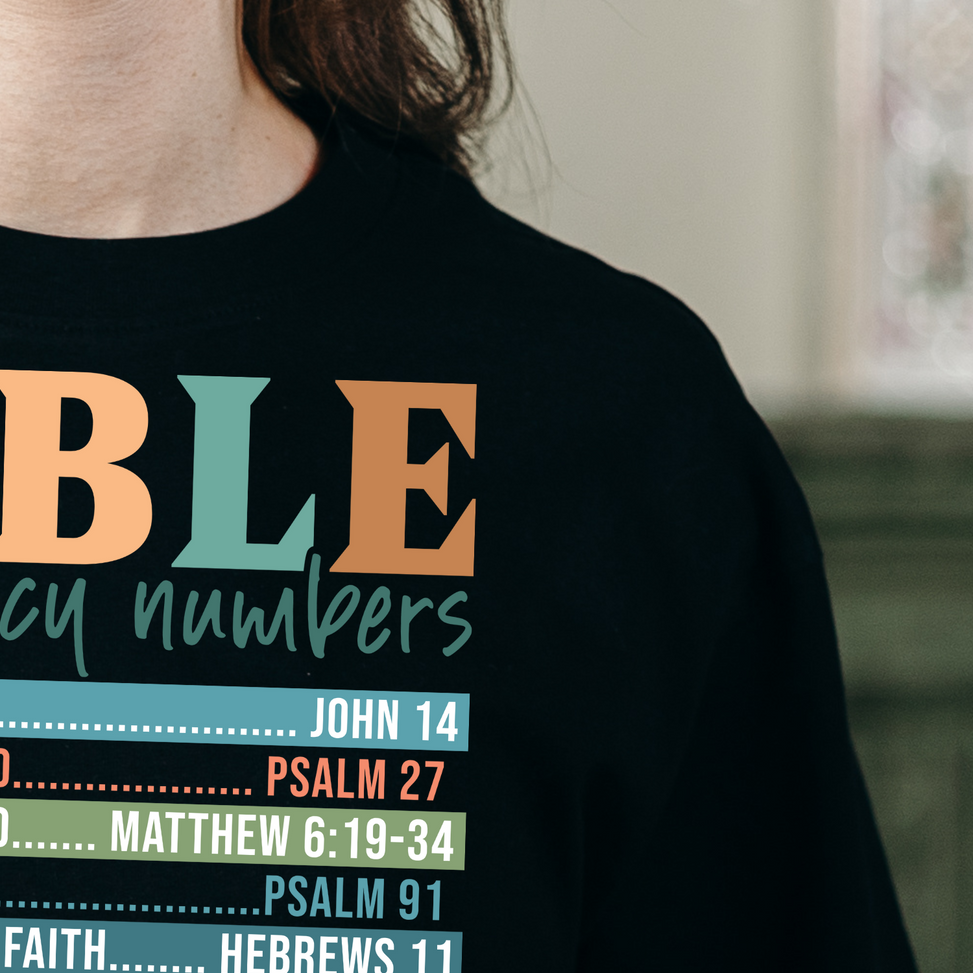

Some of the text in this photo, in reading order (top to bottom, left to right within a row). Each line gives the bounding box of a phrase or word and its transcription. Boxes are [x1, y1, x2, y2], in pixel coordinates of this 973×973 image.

[134, 553, 474, 660] numbers
[310, 697, 399, 740] JOHN
[416, 700, 458, 742] 14
[267, 755, 386, 800] PSALM
[399, 759, 445, 802] 27
[111, 810, 291, 857] MATTHEW
[304, 815, 454, 862] 6:19-34
[264, 874, 385, 919] PSALM
[398, 878, 441, 921] 91
